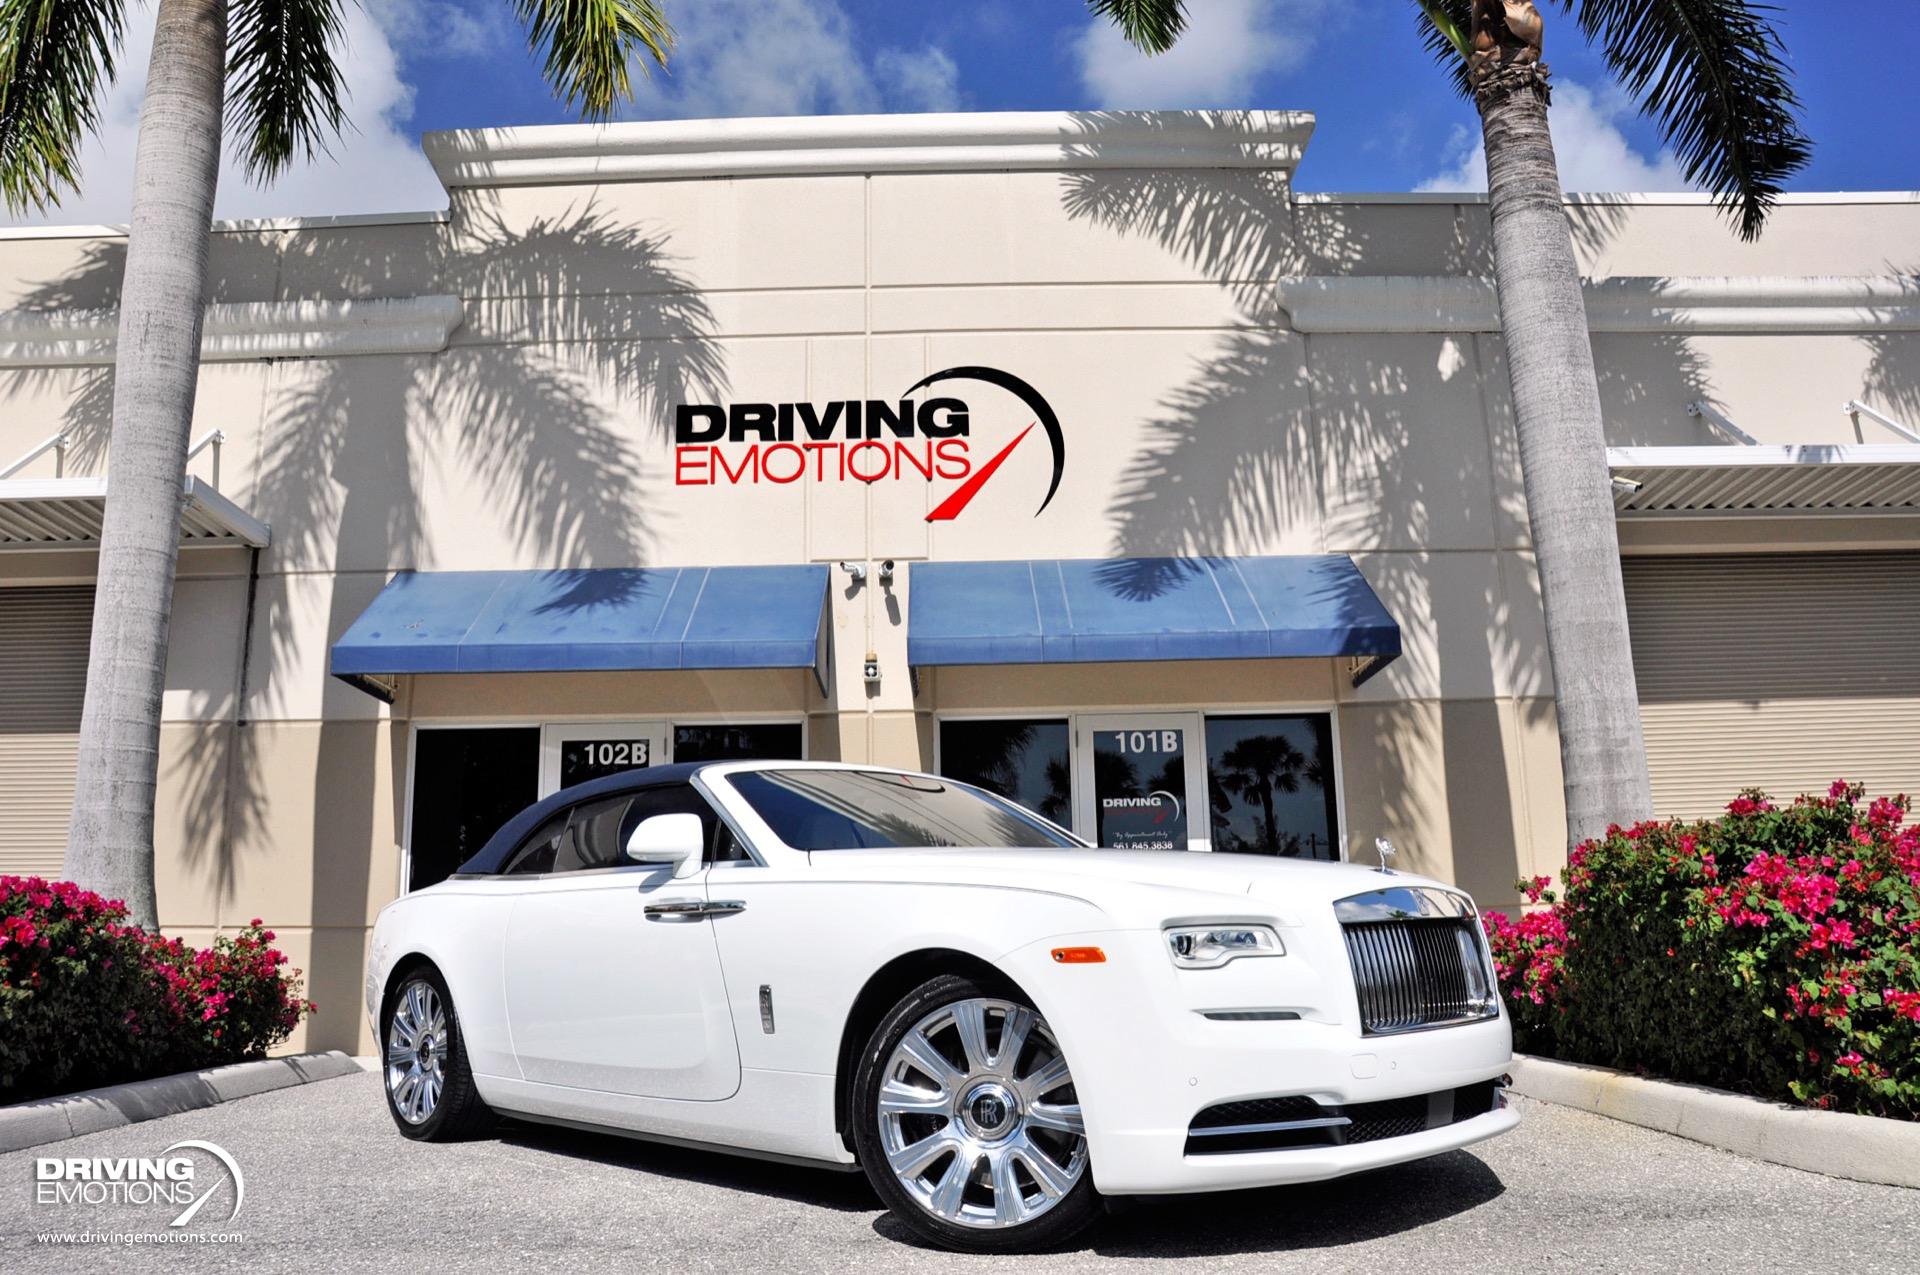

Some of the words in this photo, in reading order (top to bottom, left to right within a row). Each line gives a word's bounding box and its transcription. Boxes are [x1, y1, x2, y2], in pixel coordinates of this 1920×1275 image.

[675, 397, 969, 443] DRIVING
[675, 439, 970, 486] EMOTIONS
[1115, 731, 1177, 753] 101B
[584, 743, 647, 765] 102B
[1103, 797, 1161, 808] DRIVING
[1113, 841, 1173, 850] 561845.3838
